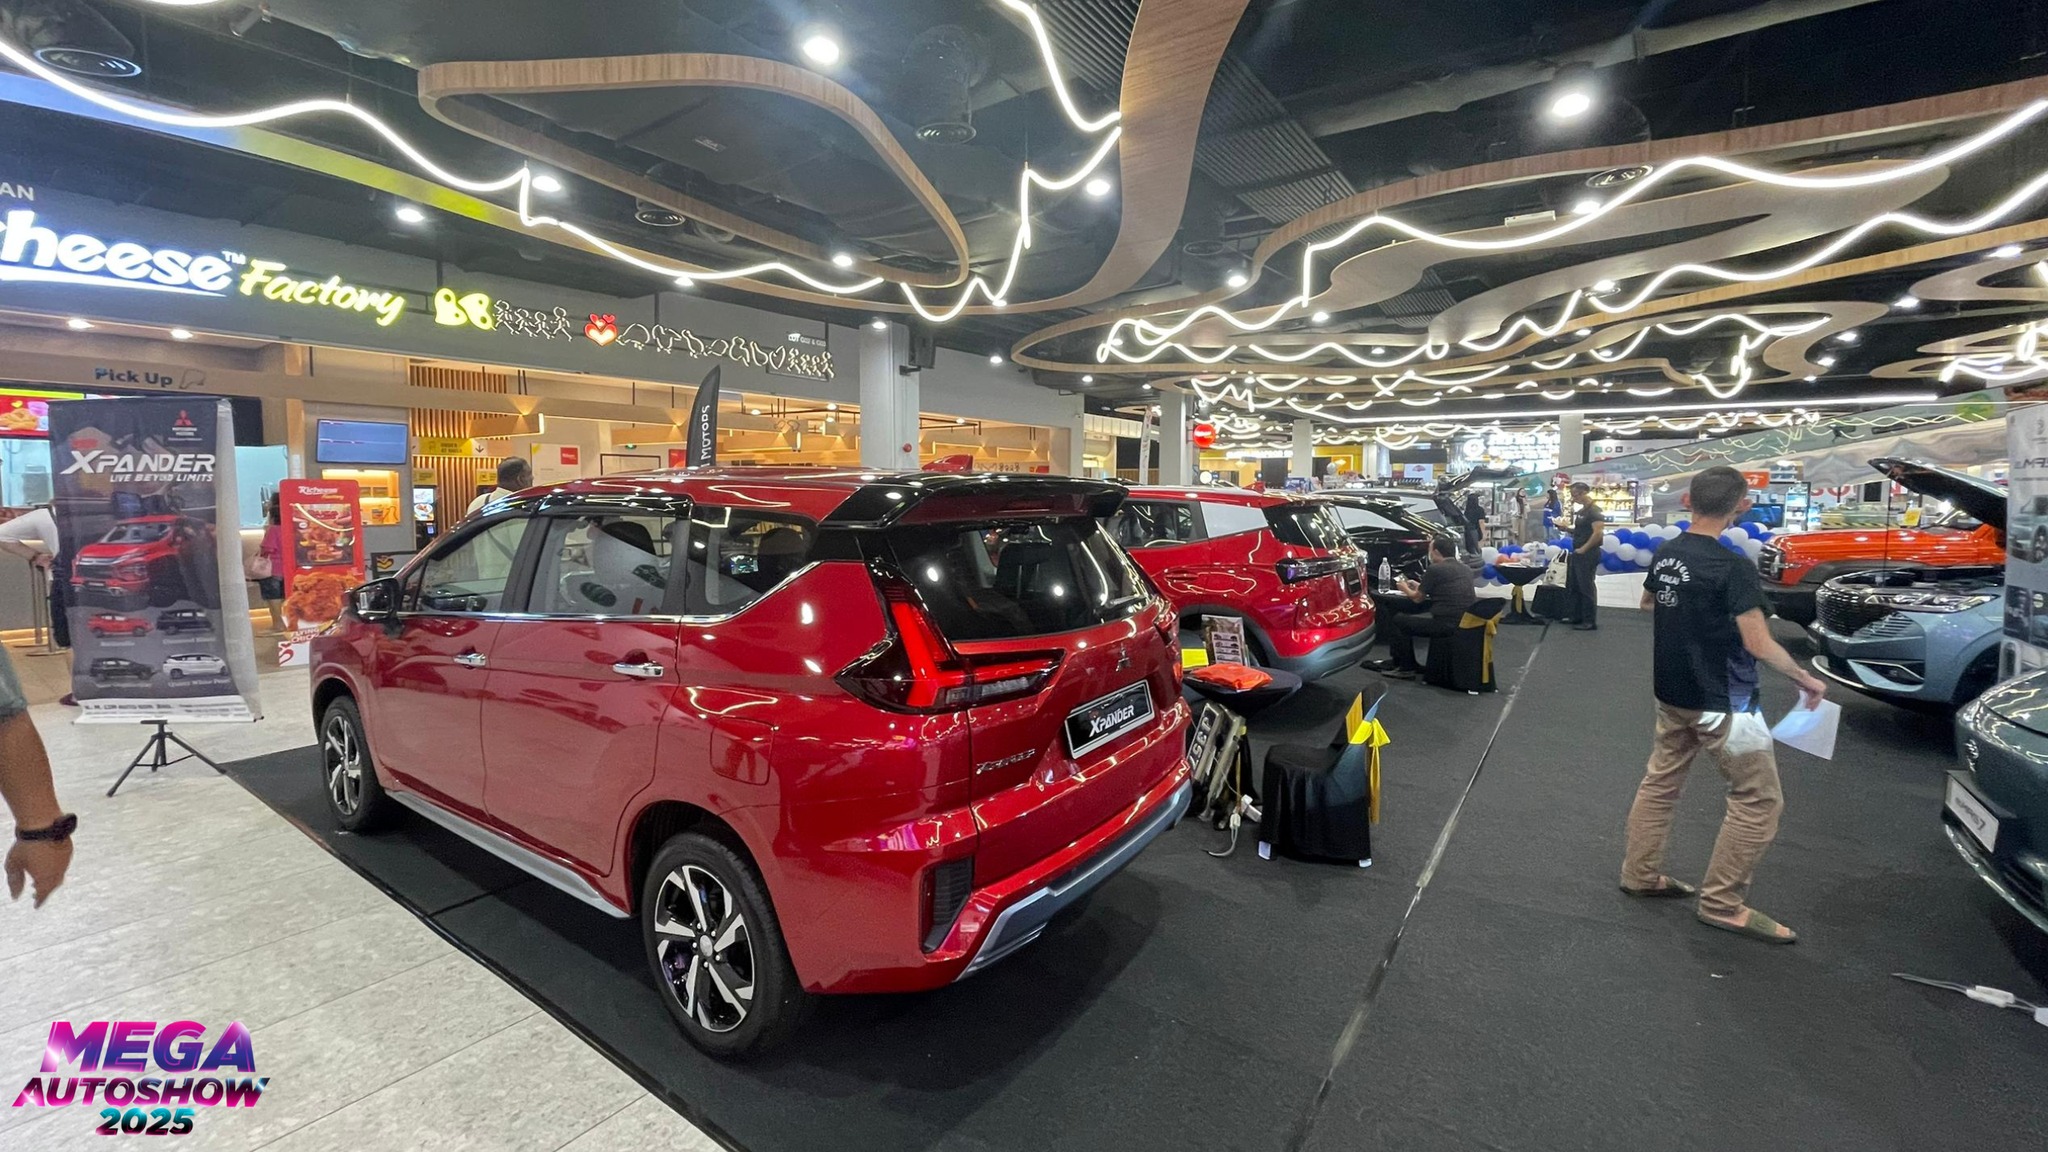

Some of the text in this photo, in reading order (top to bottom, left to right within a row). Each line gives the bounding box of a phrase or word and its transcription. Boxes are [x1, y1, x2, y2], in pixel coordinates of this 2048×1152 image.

[0, 209, 232, 289] heese
[240, 258, 406, 326] Factory
[95, 367, 173, 386] Pick Up
[60, 450, 216, 474] XPANDER
[110, 474, 131, 482] LIVE
[176, 473, 214, 482] LIMITS
[1089, 705, 1134, 737] XPANDER
